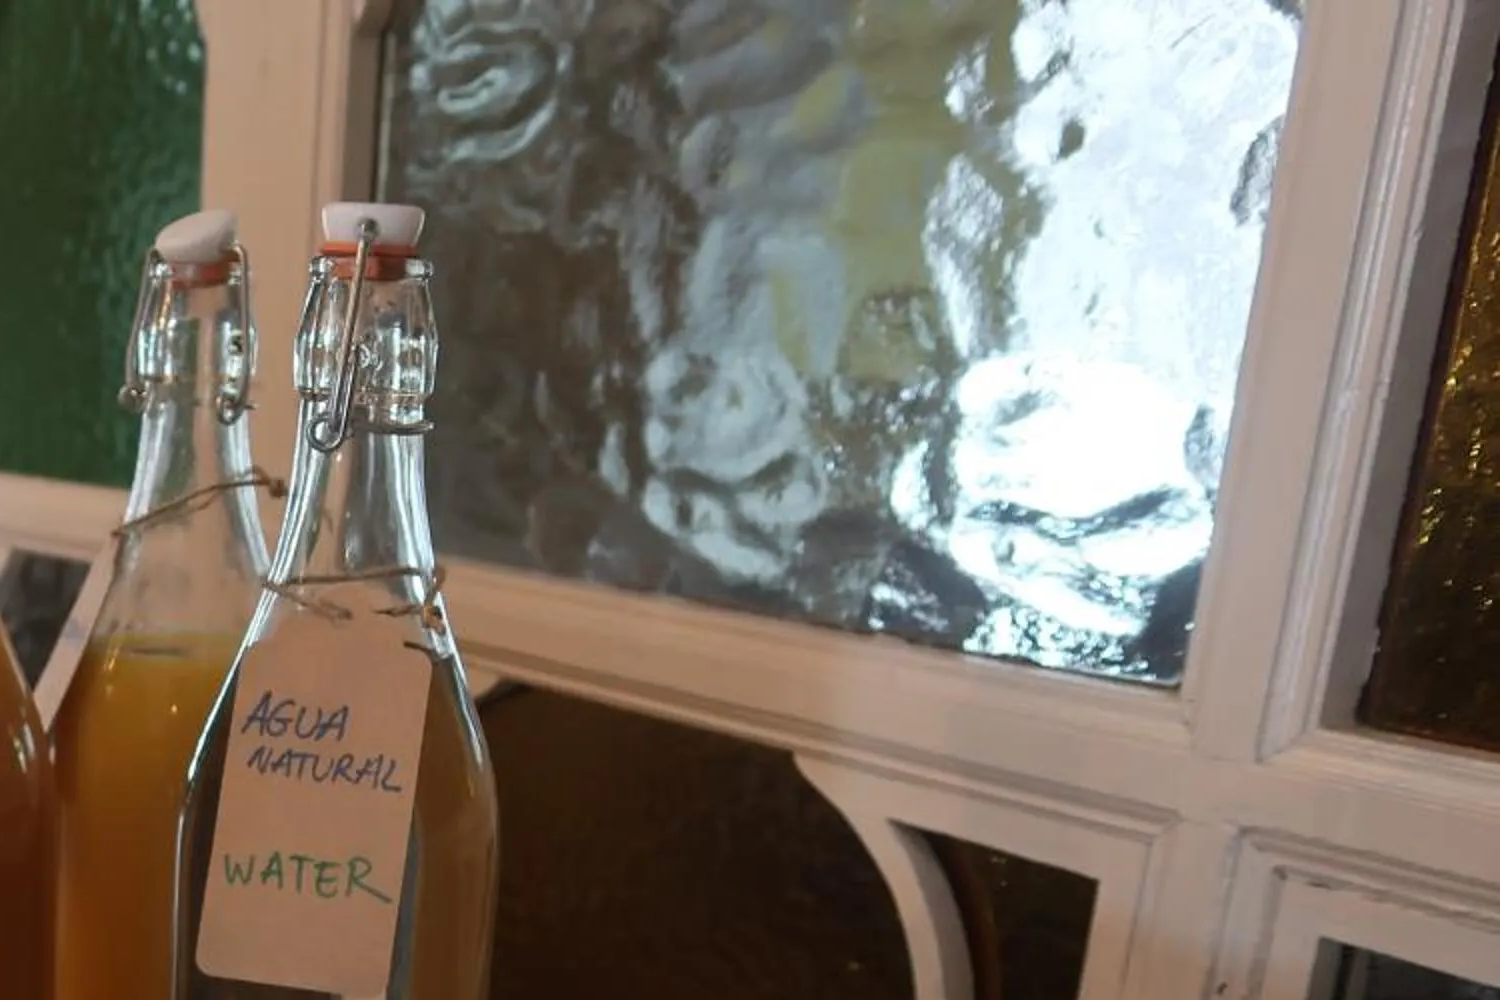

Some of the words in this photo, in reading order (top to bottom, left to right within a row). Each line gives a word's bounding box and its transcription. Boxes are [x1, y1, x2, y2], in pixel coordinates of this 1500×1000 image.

[242, 690, 348, 741] AGUA
[248, 746, 402, 793] NATURAL
[224, 851, 393, 904] WATER
